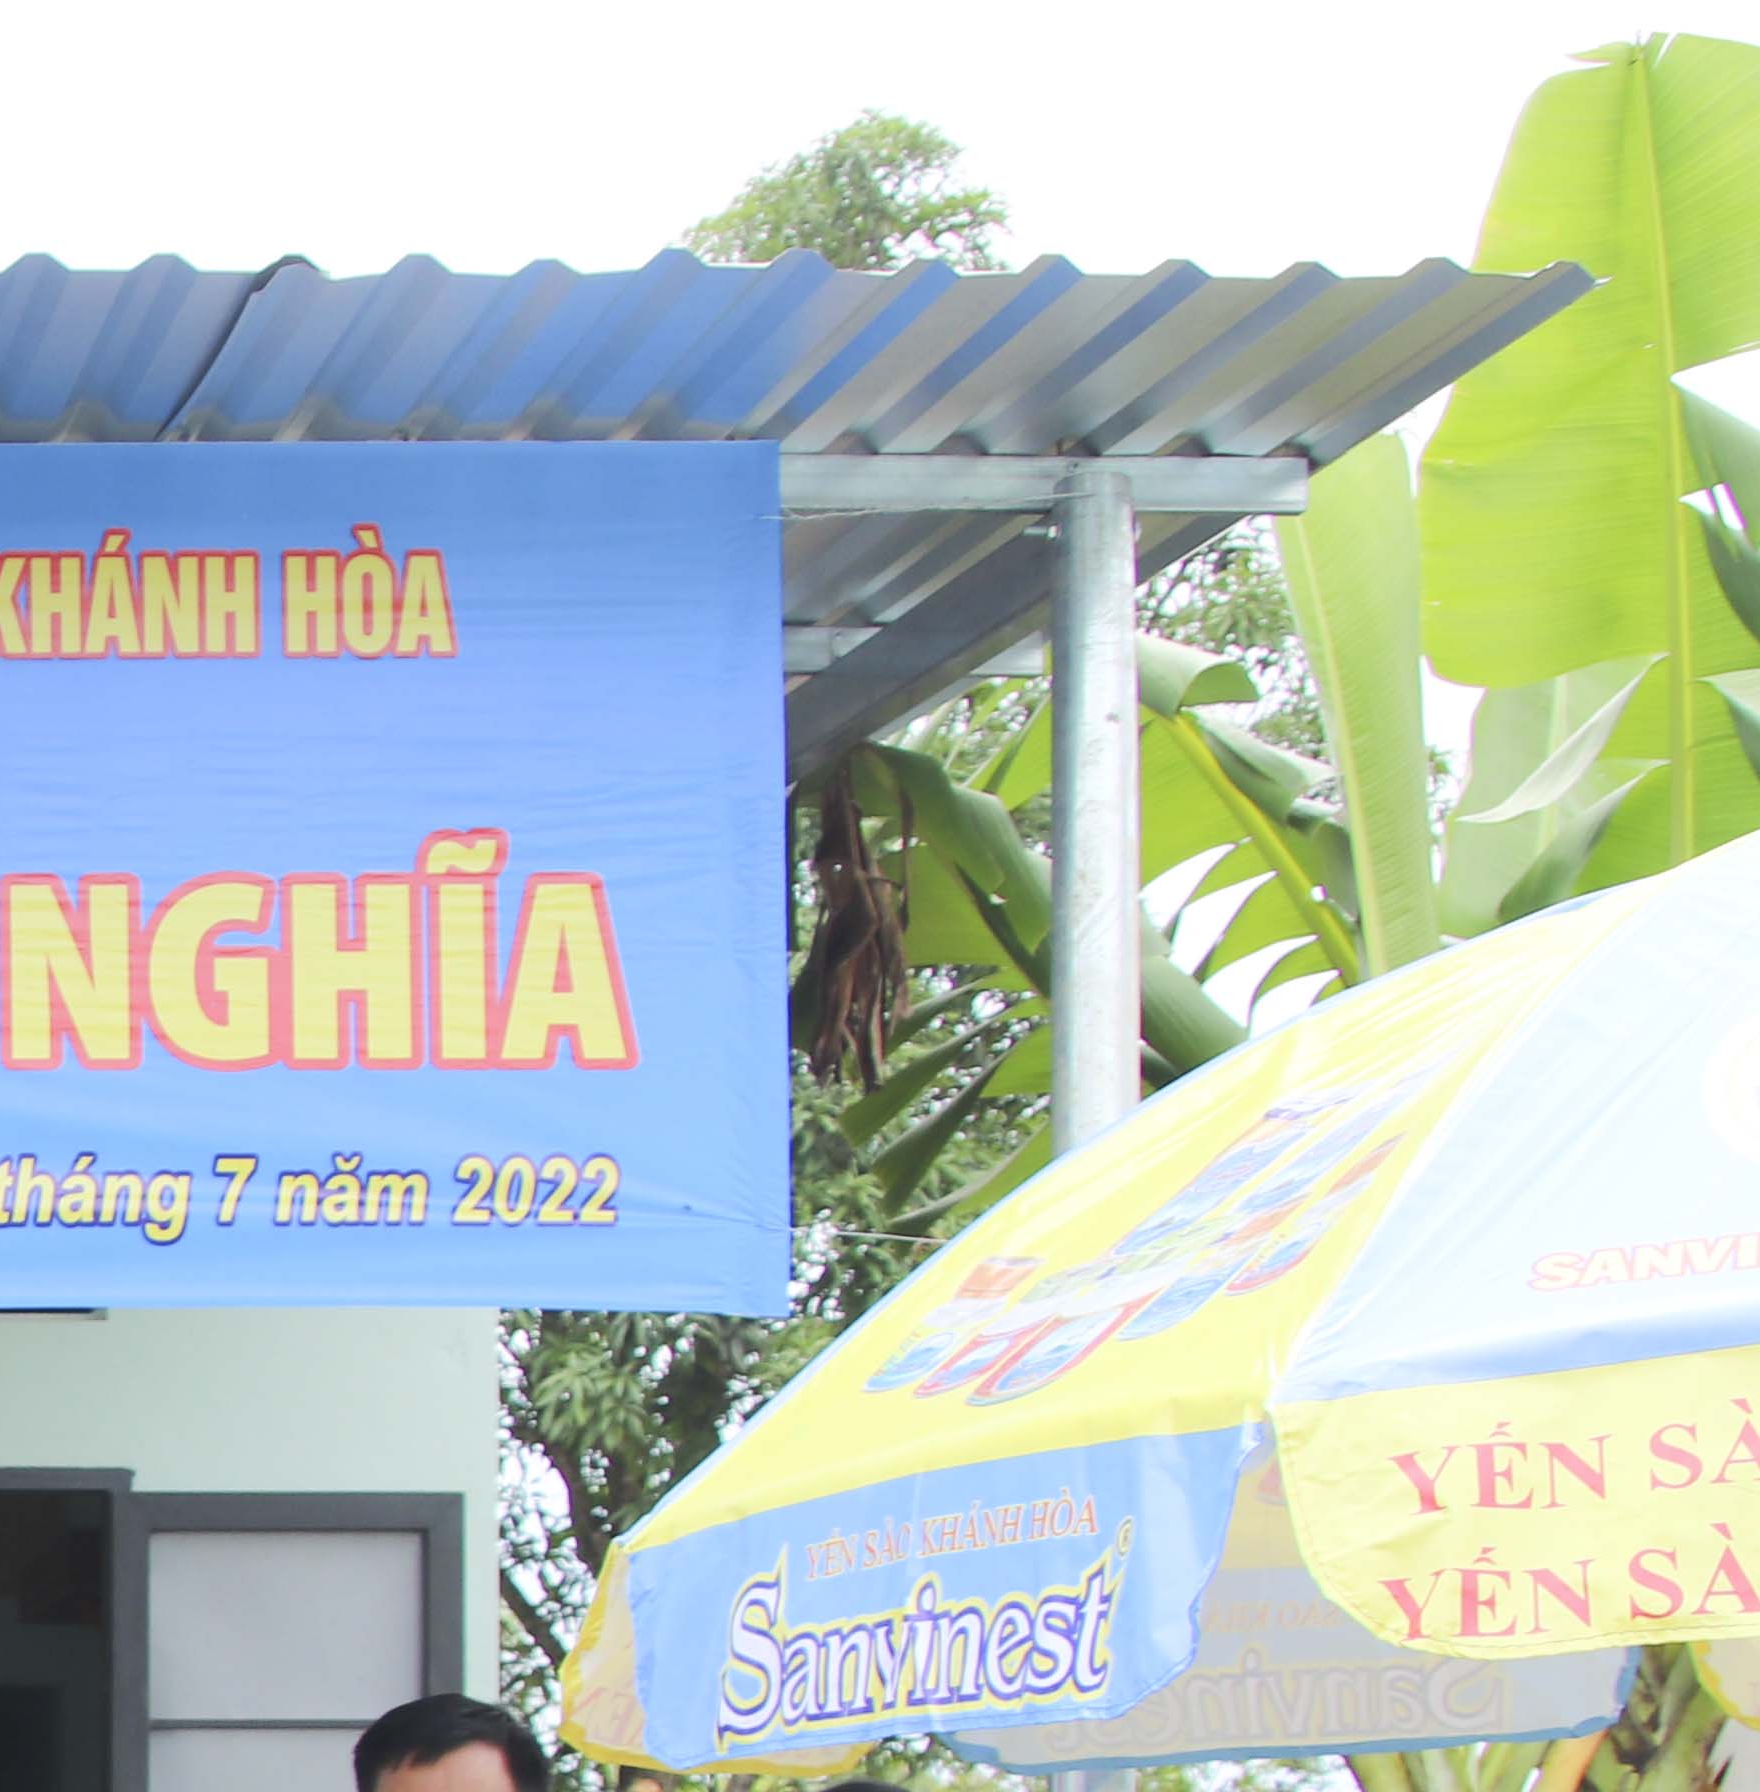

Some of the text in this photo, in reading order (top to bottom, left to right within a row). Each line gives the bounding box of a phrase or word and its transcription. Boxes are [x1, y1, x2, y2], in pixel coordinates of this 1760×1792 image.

[284, 524, 456, 658] HÒA
[0, 828, 642, 1072] NGHĨA
[215, 1154, 259, 1224] 7
[276, 1153, 430, 1226] năm
[453, 1153, 621, 1226] 2022
[1384, 1420, 1613, 1516] YẾN
[918, 1500, 1022, 1559] KHÁNH
[1028, 1487, 1100, 1543] HÒA
[1377, 1546, 1596, 1643] YẾN
[715, 1547, 1123, 1752] Sanvinest
